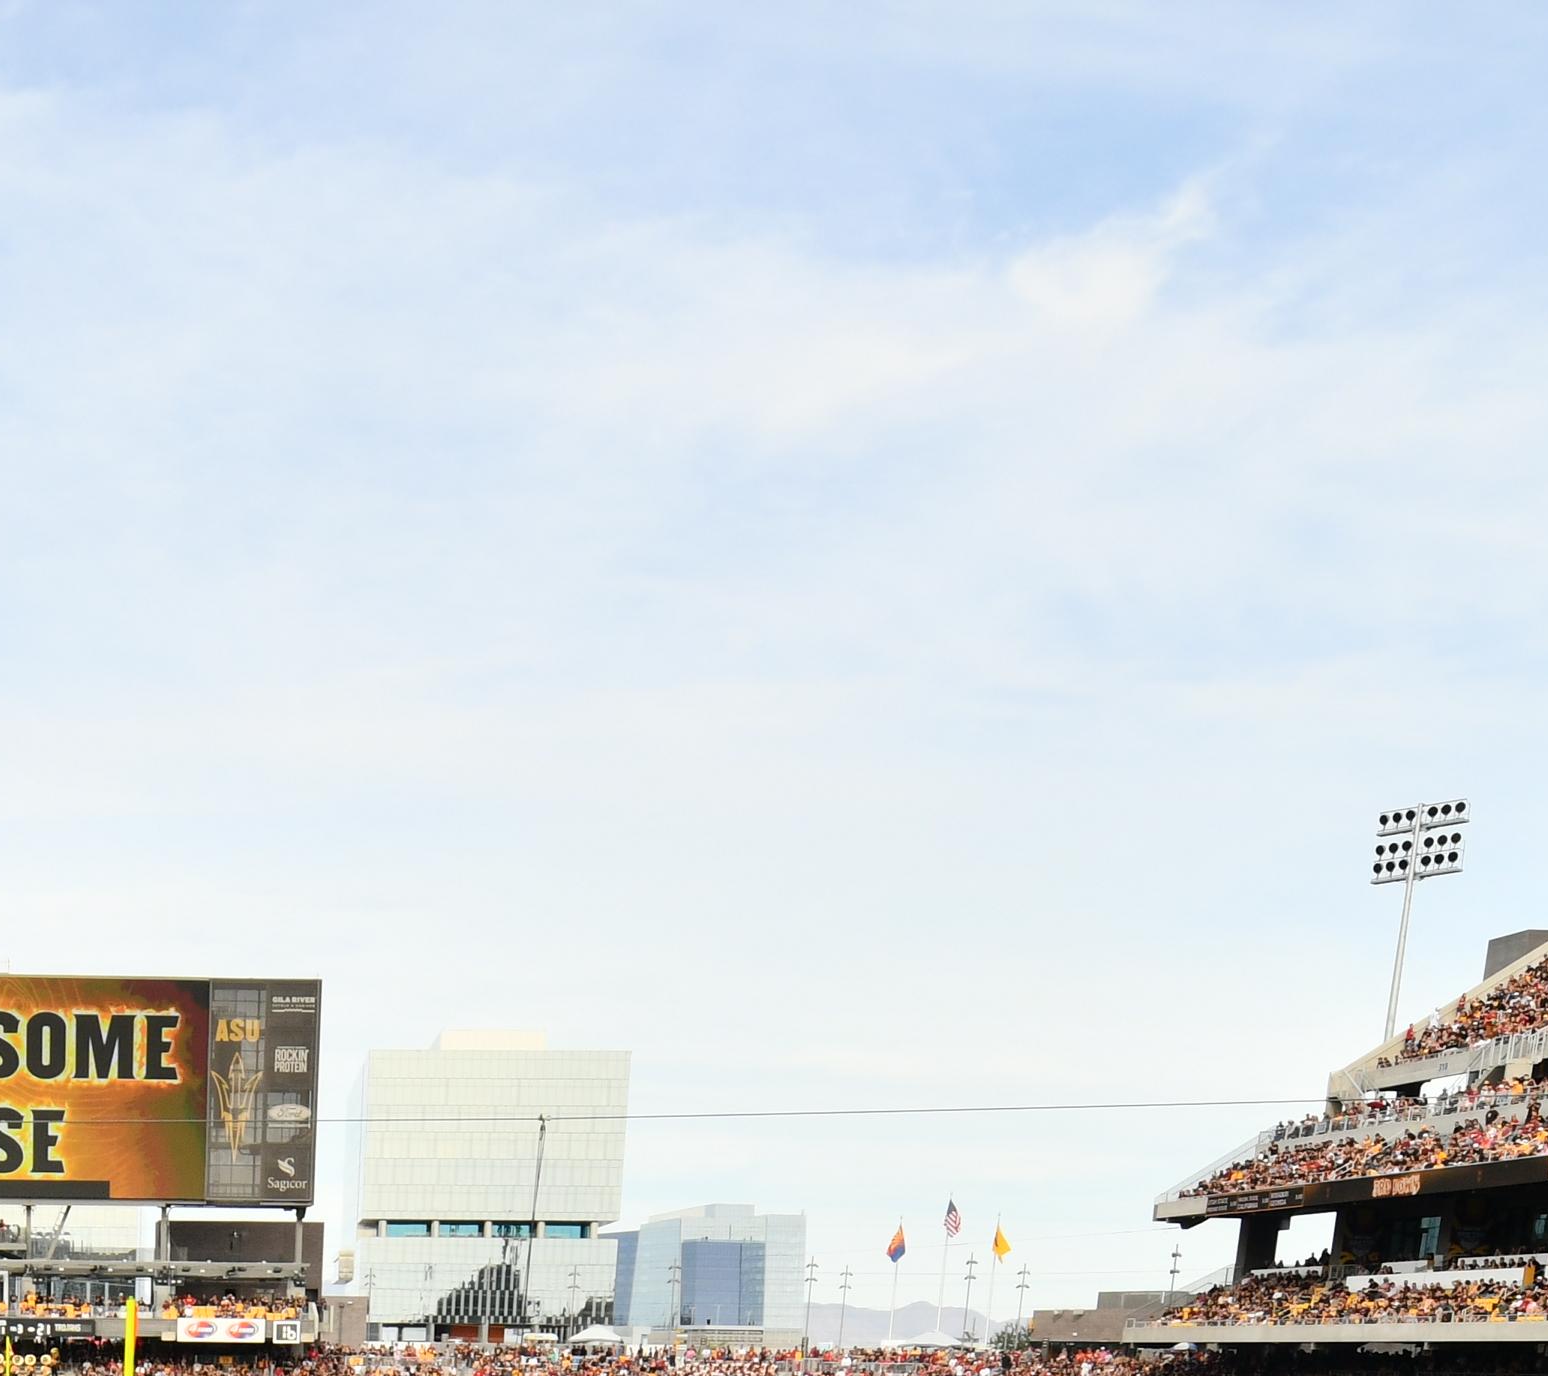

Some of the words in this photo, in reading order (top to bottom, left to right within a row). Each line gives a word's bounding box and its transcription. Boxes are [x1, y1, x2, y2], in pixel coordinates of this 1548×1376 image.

[215, 1019, 261, 1042] ASU
[274, 1061, 308, 1073] PROTEIN
[267, 1177, 308, 1191] Sagicor
[36, 1323, 51, 1335] 21
